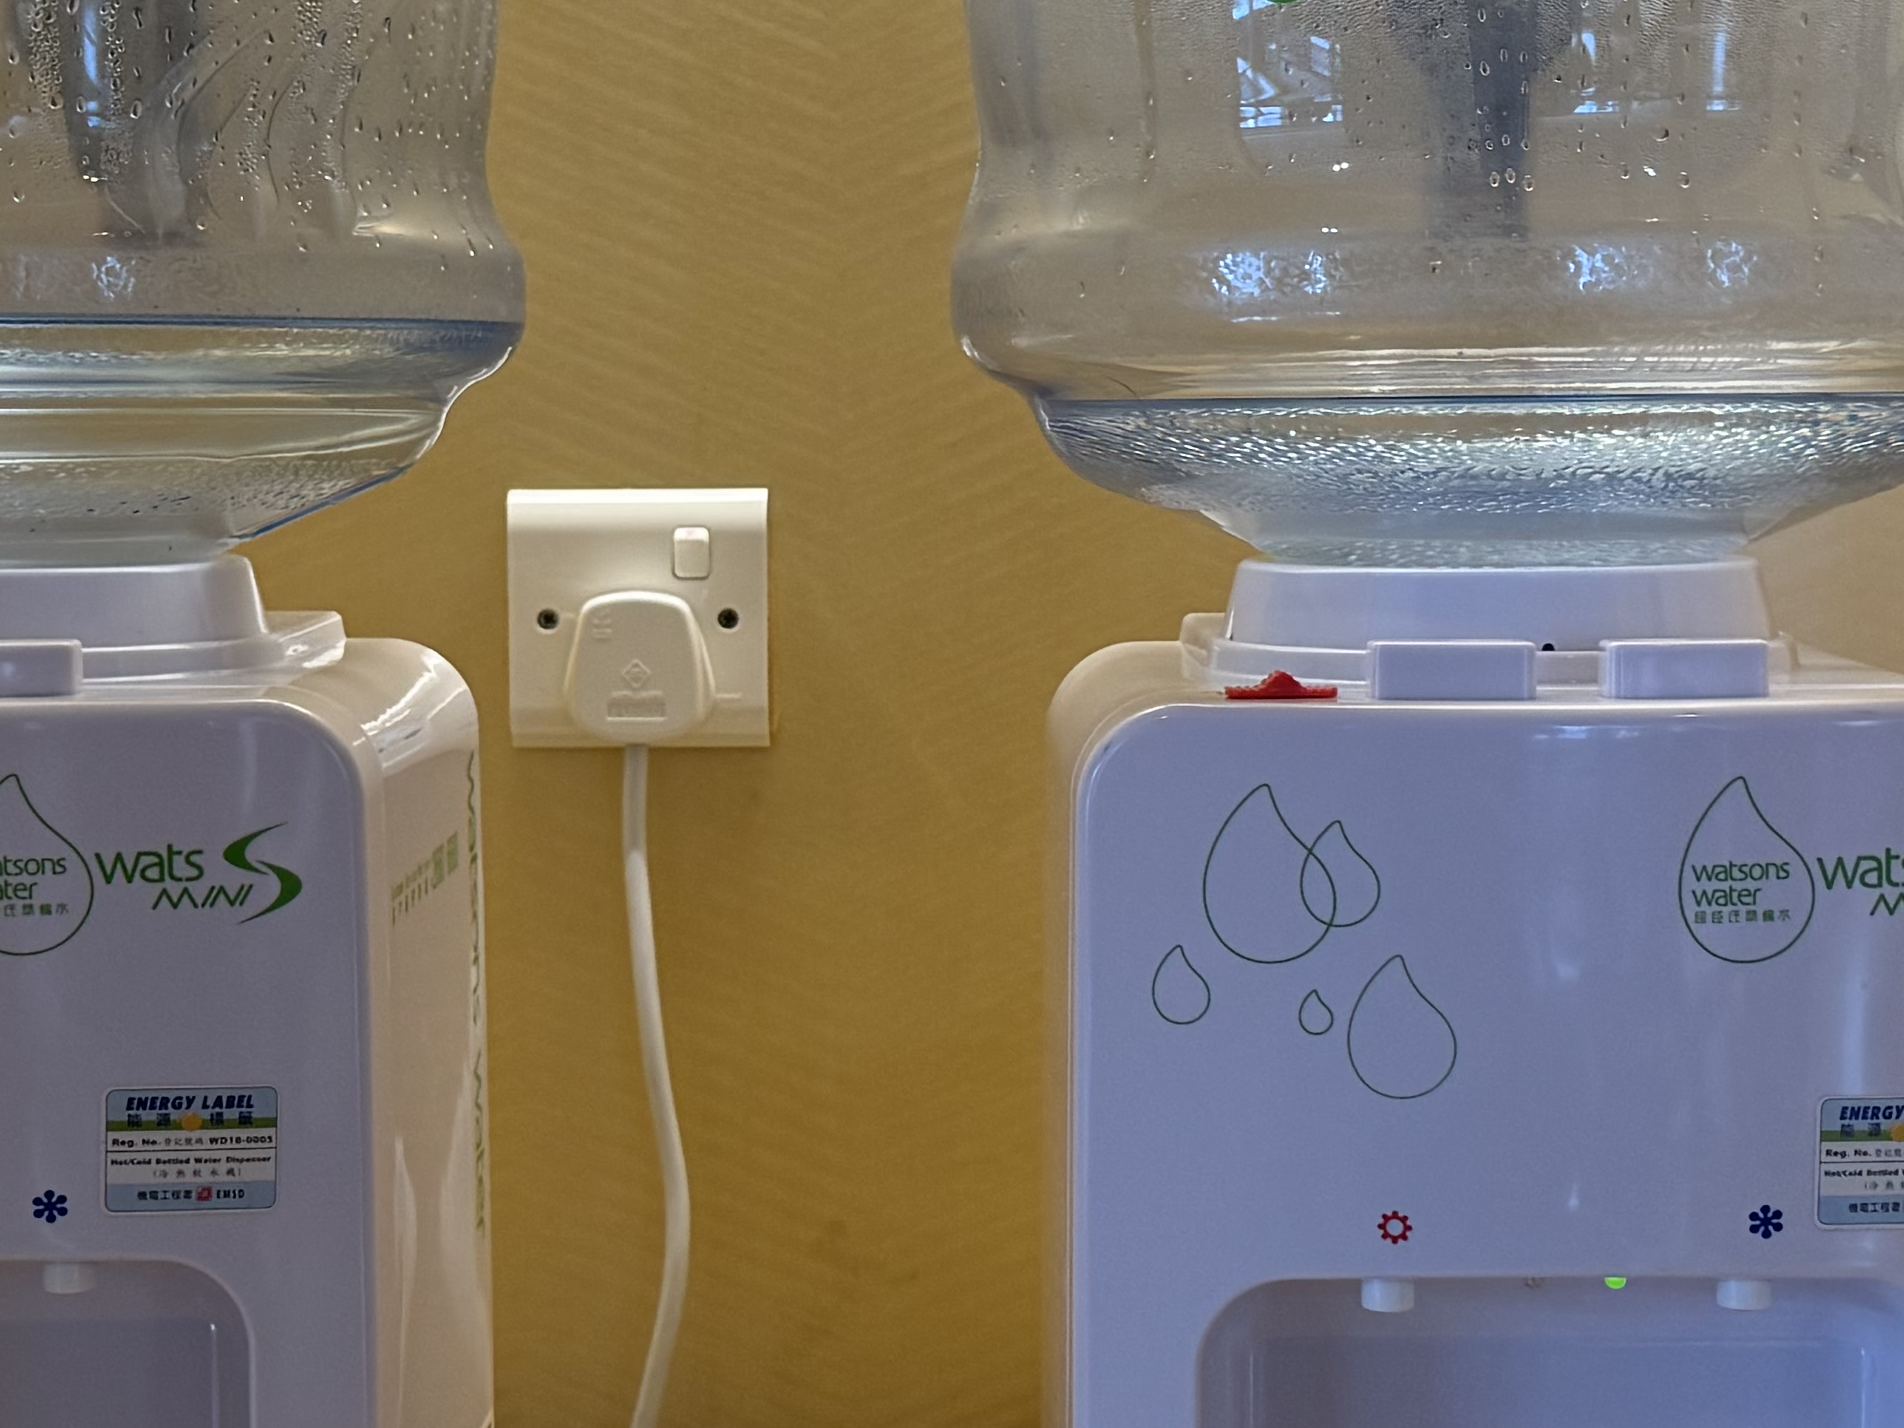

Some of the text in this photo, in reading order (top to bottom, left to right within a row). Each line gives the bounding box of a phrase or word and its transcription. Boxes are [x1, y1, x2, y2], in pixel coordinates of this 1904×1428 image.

[1691, 861, 1790, 882] watsons
[152, 884, 254, 910] MINI
[1691, 885, 1762, 907] water
[126, 1094, 255, 1111] ENERGY LABEL
[1839, 1105, 1904, 1121] ENERGY
